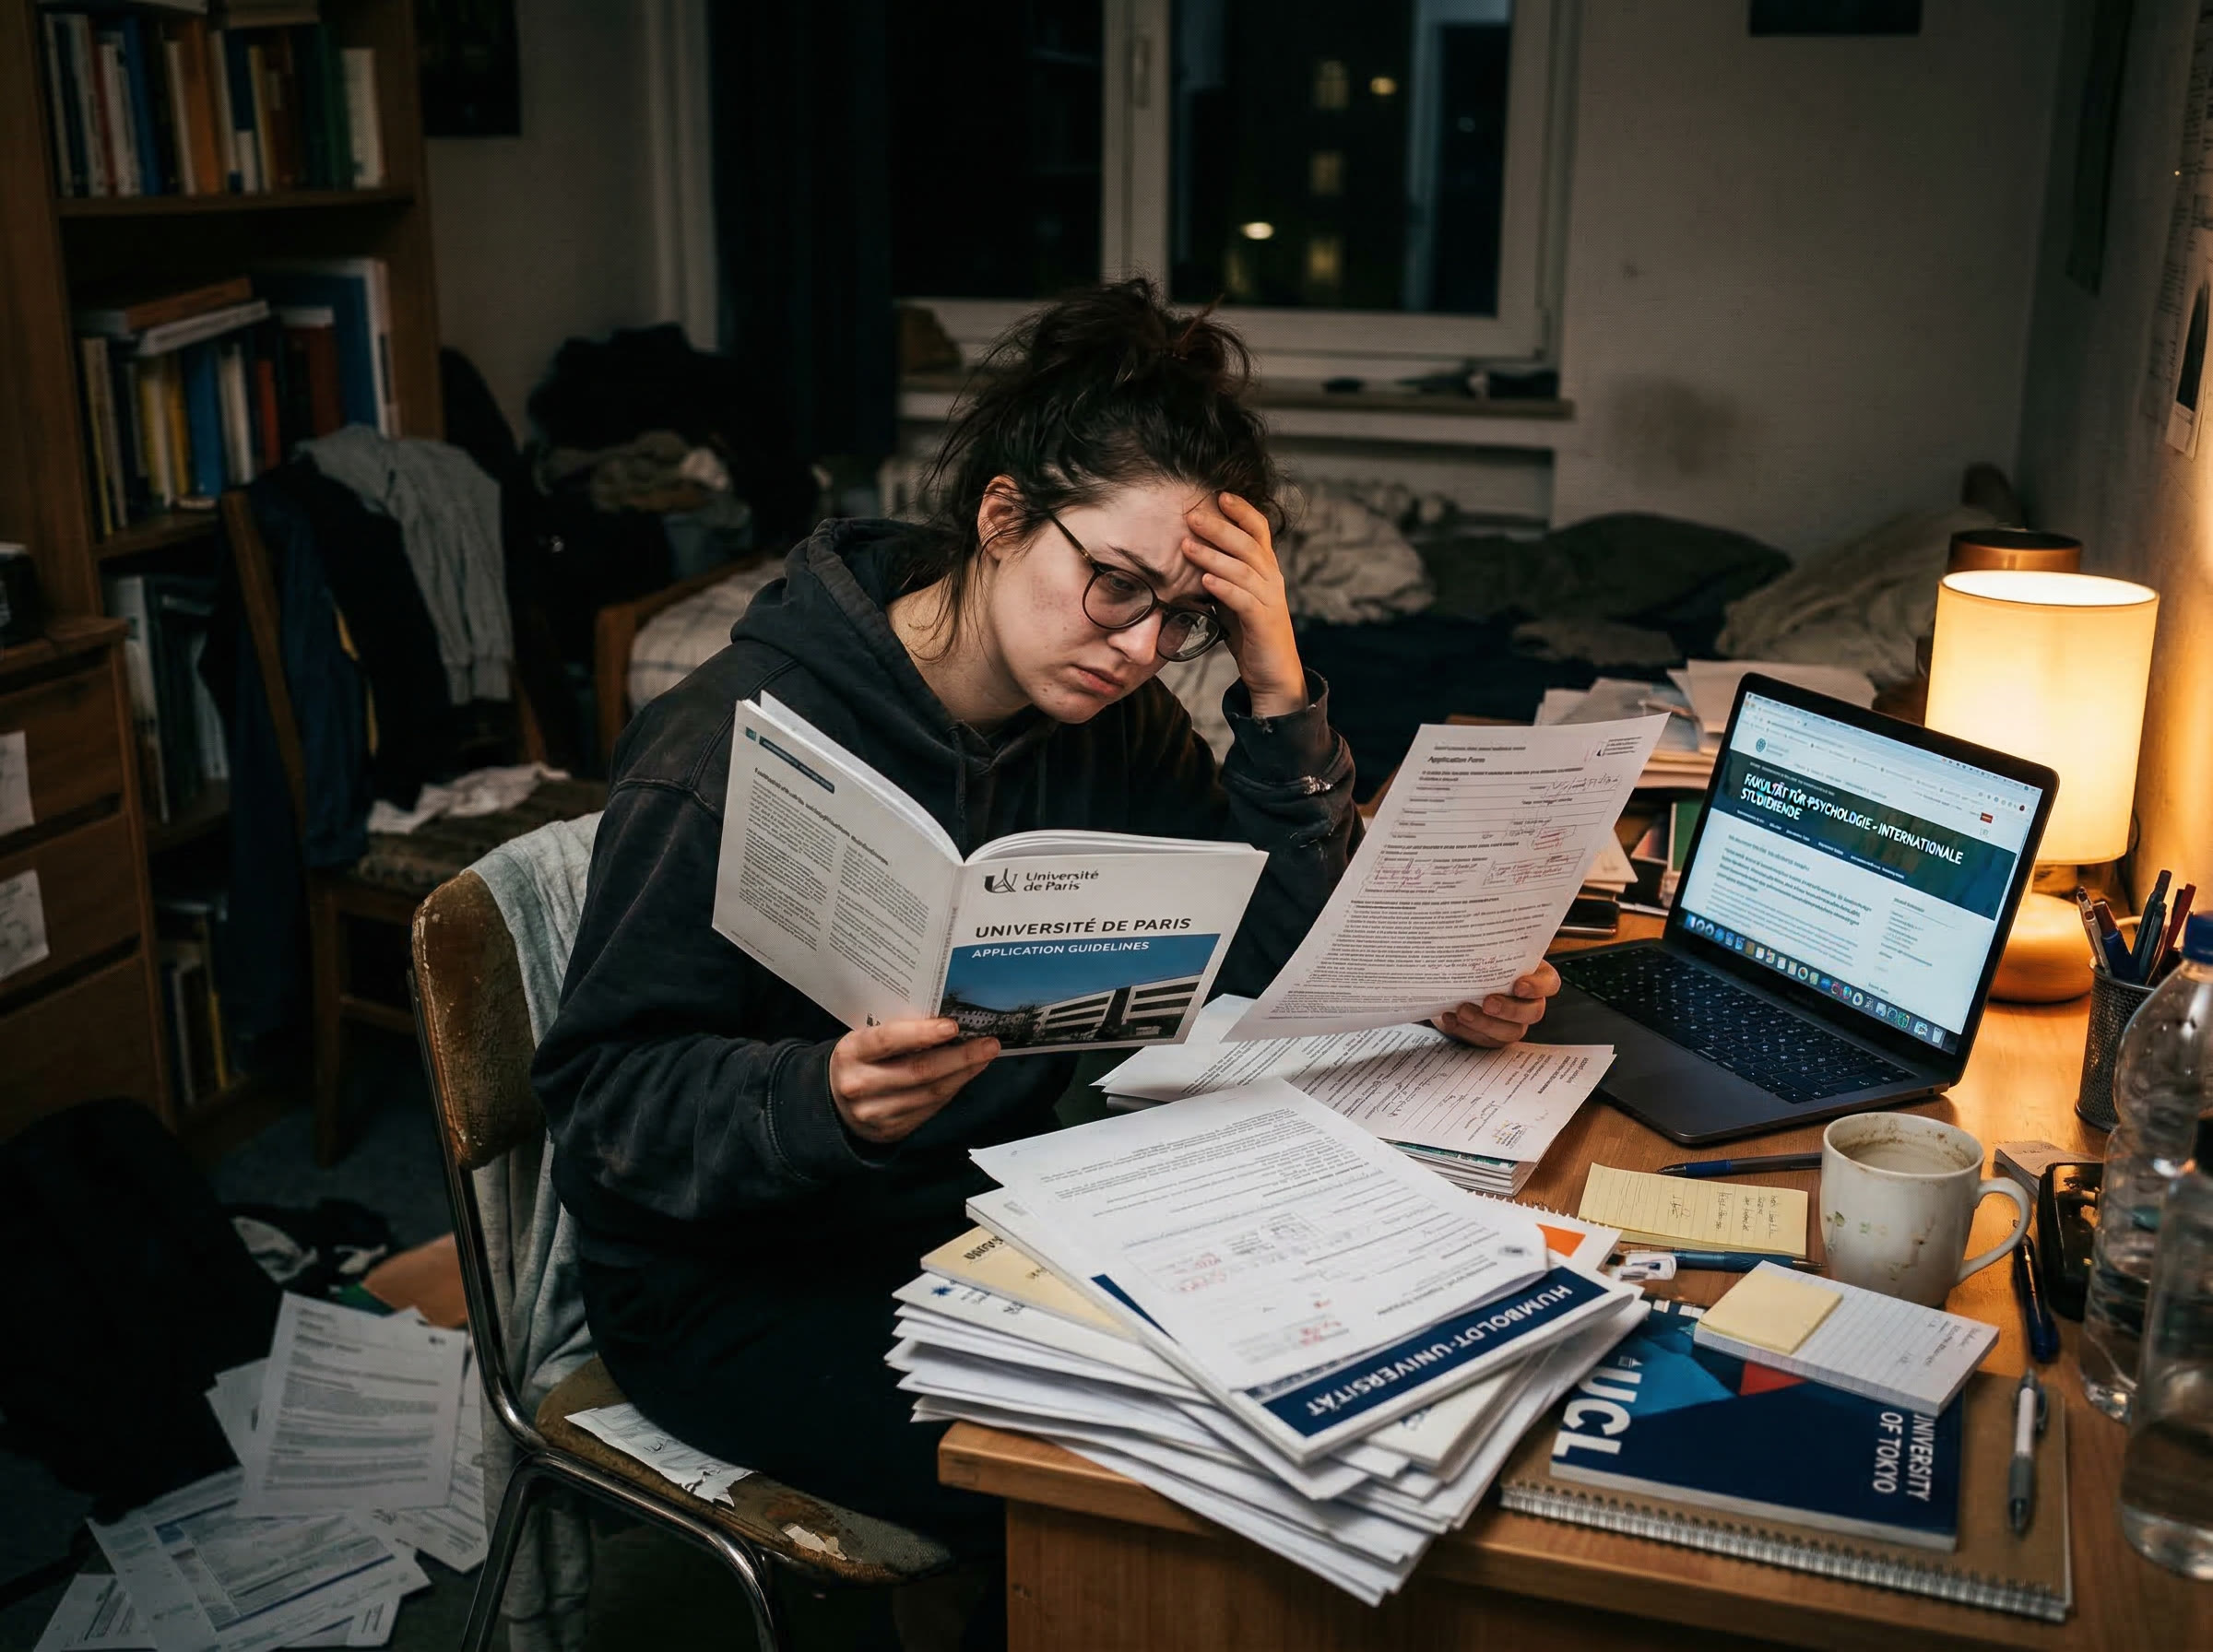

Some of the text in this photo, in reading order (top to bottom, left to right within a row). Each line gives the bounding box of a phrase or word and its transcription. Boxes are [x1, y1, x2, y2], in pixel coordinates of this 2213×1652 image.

[1806, 796, 1873, 831] PSYCHOLOGIE
[1877, 824, 1964, 865] INTERNATIONALE
[1025, 869, 1099, 882] Université
[1024, 881, 1081, 892] de Paris
[976, 918, 1192, 938] UNIVERSITÉ DE PARIS
[971, 941, 1150, 959] APPLICATION GUIDELINES
[1553, 1366, 1643, 1457] UCL
[1873, 1411, 1904, 1494] OF TOKYO
